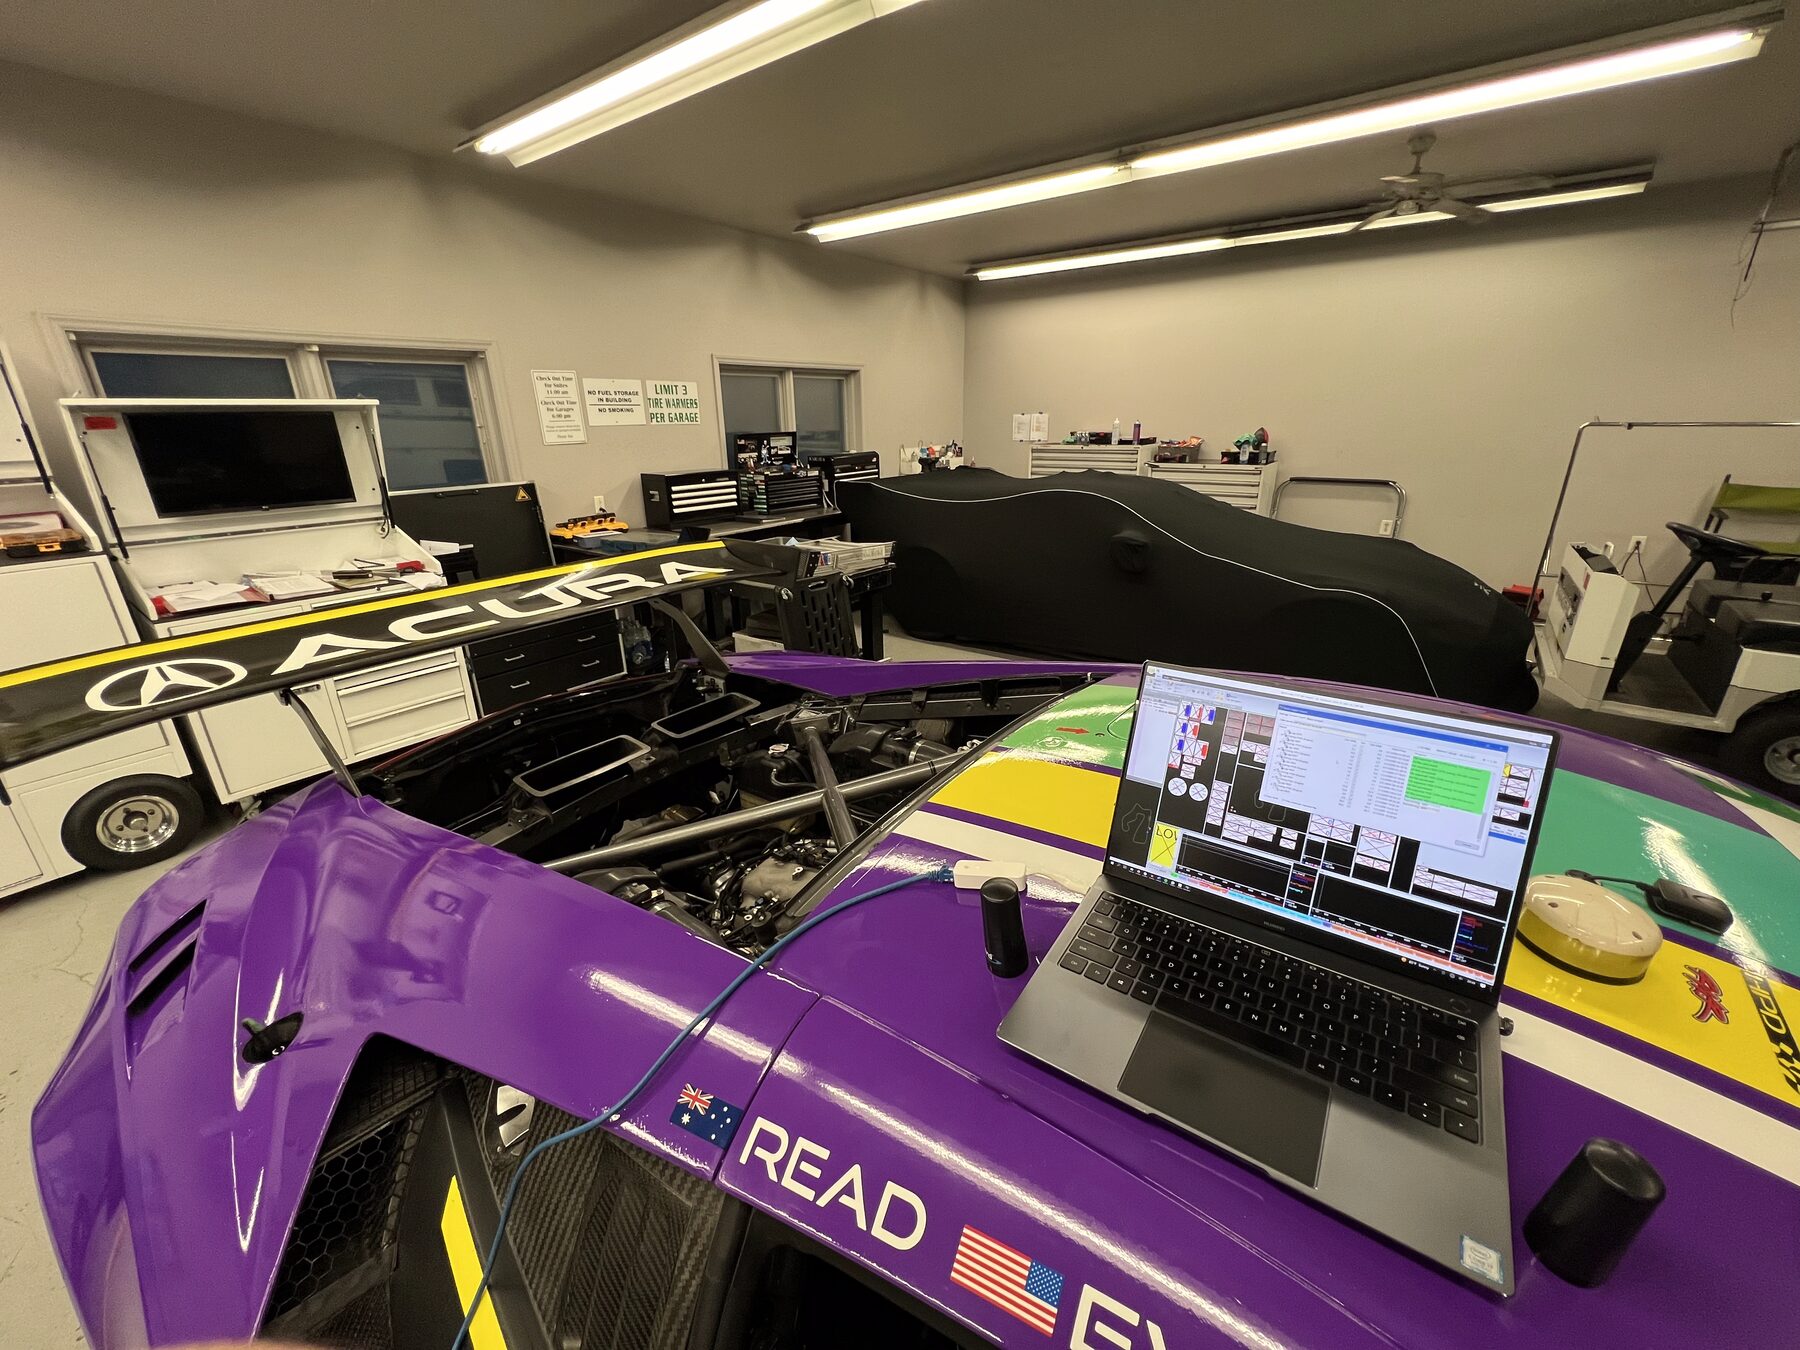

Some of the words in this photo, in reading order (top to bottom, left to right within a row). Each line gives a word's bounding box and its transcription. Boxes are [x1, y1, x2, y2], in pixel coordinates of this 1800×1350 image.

[654, 384, 679, 395] LIMIT
[682, 384, 688, 395] 3
[647, 398, 664, 409] TIRE
[665, 398, 698, 409] WARMERS
[650, 412, 665, 423] PER
[668, 412, 699, 423] GARAGE
[271, 561, 734, 676] ACURA
[739, 1116, 928, 1251] READ
